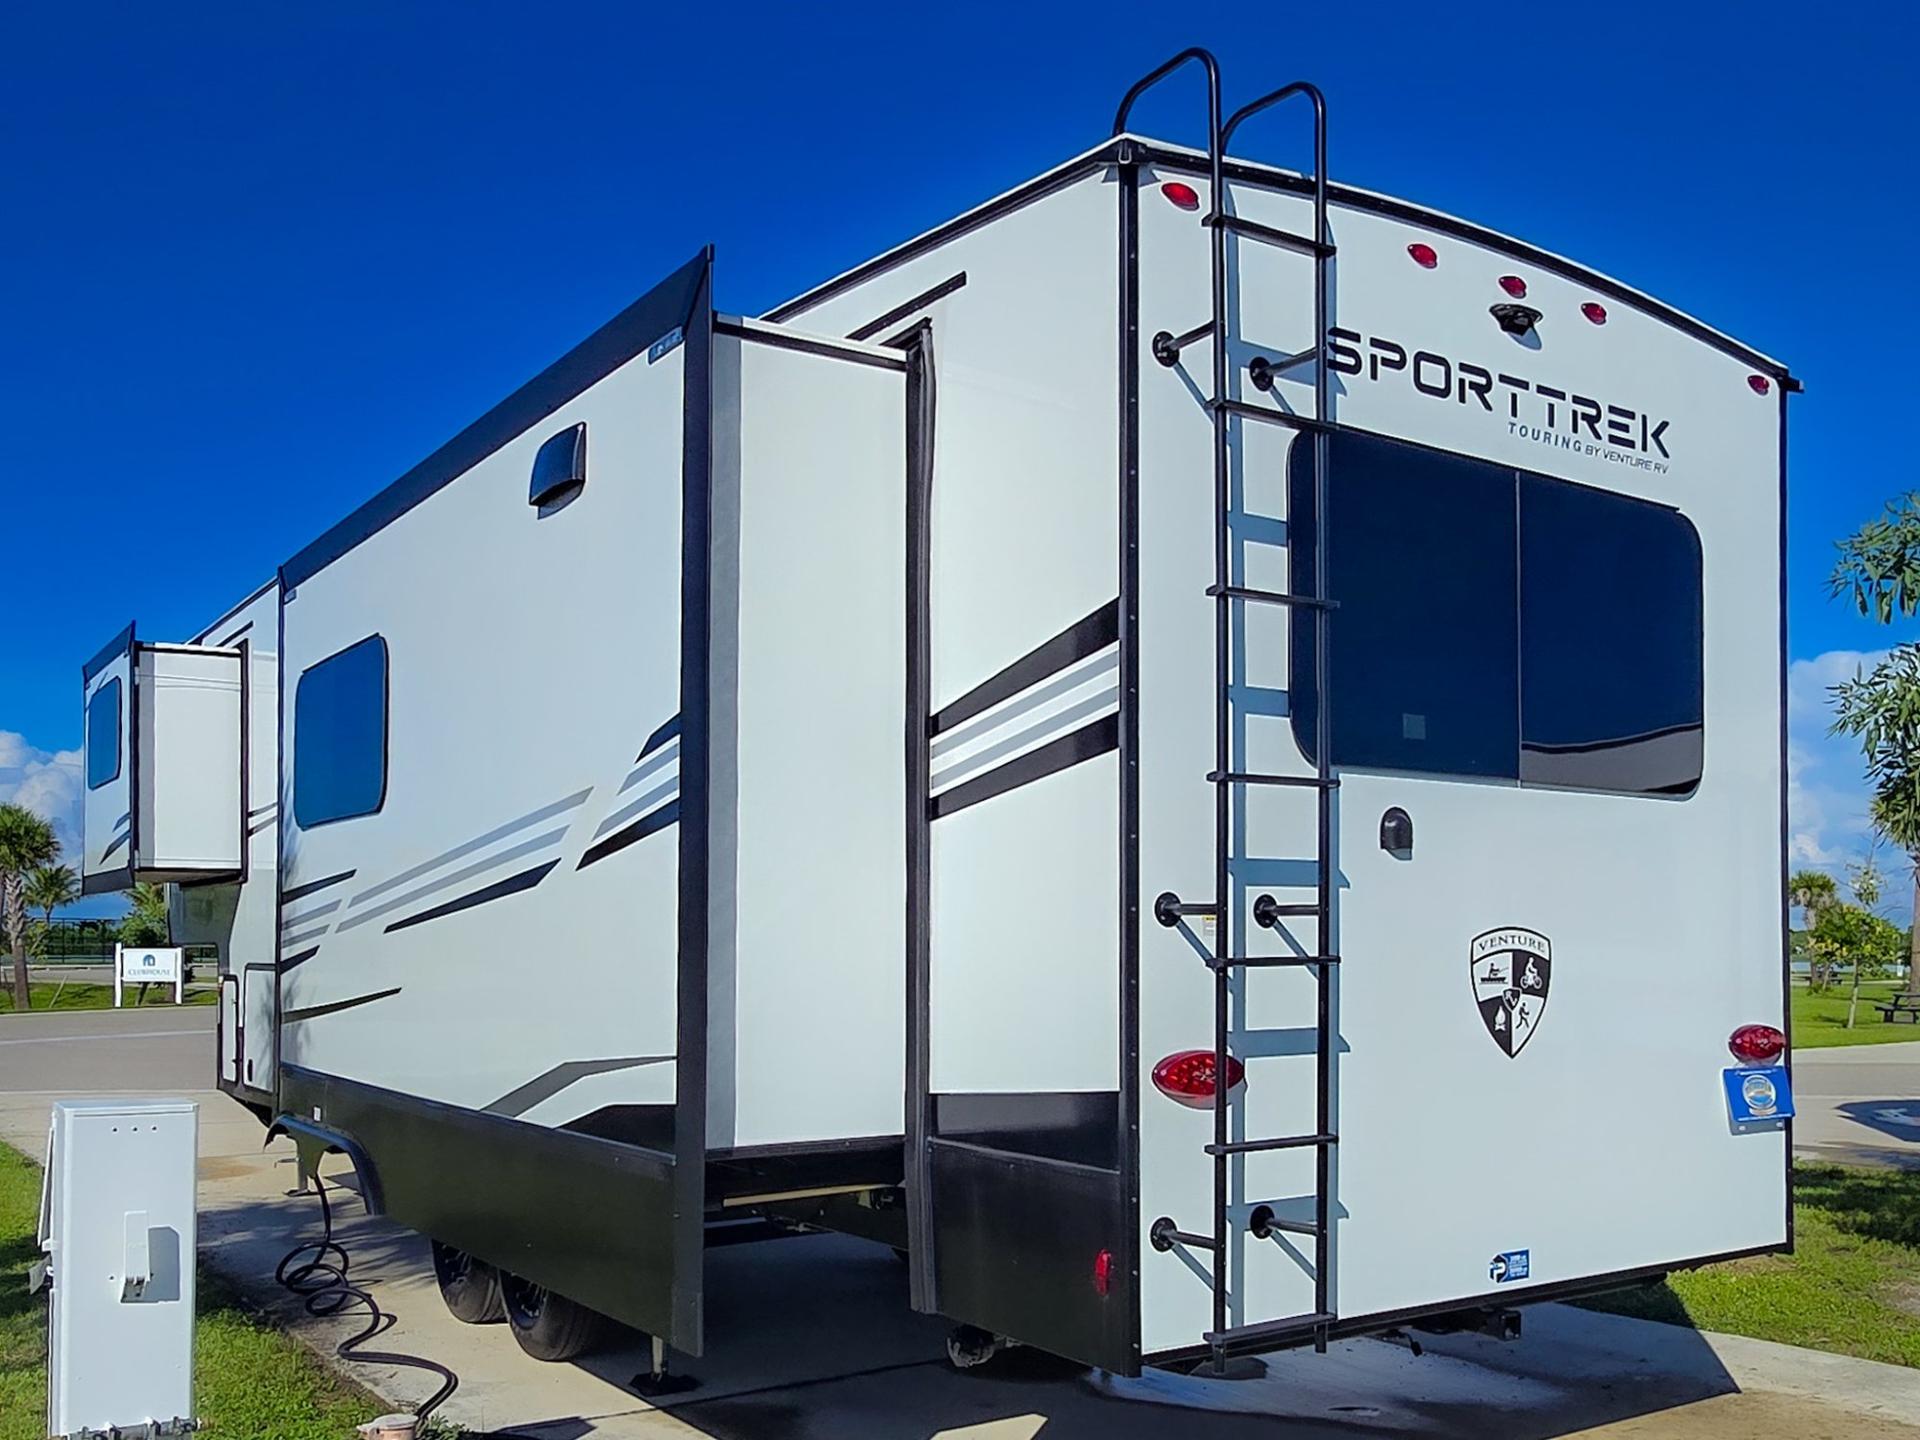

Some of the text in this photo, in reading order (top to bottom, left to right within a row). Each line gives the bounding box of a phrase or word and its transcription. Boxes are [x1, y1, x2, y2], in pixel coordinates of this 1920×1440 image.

[1327, 326, 1671, 459] SPORTTREK
[1508, 421, 1670, 475] TOURING BY VENTURE RV
[1479, 935, 1546, 953] VENTURE
